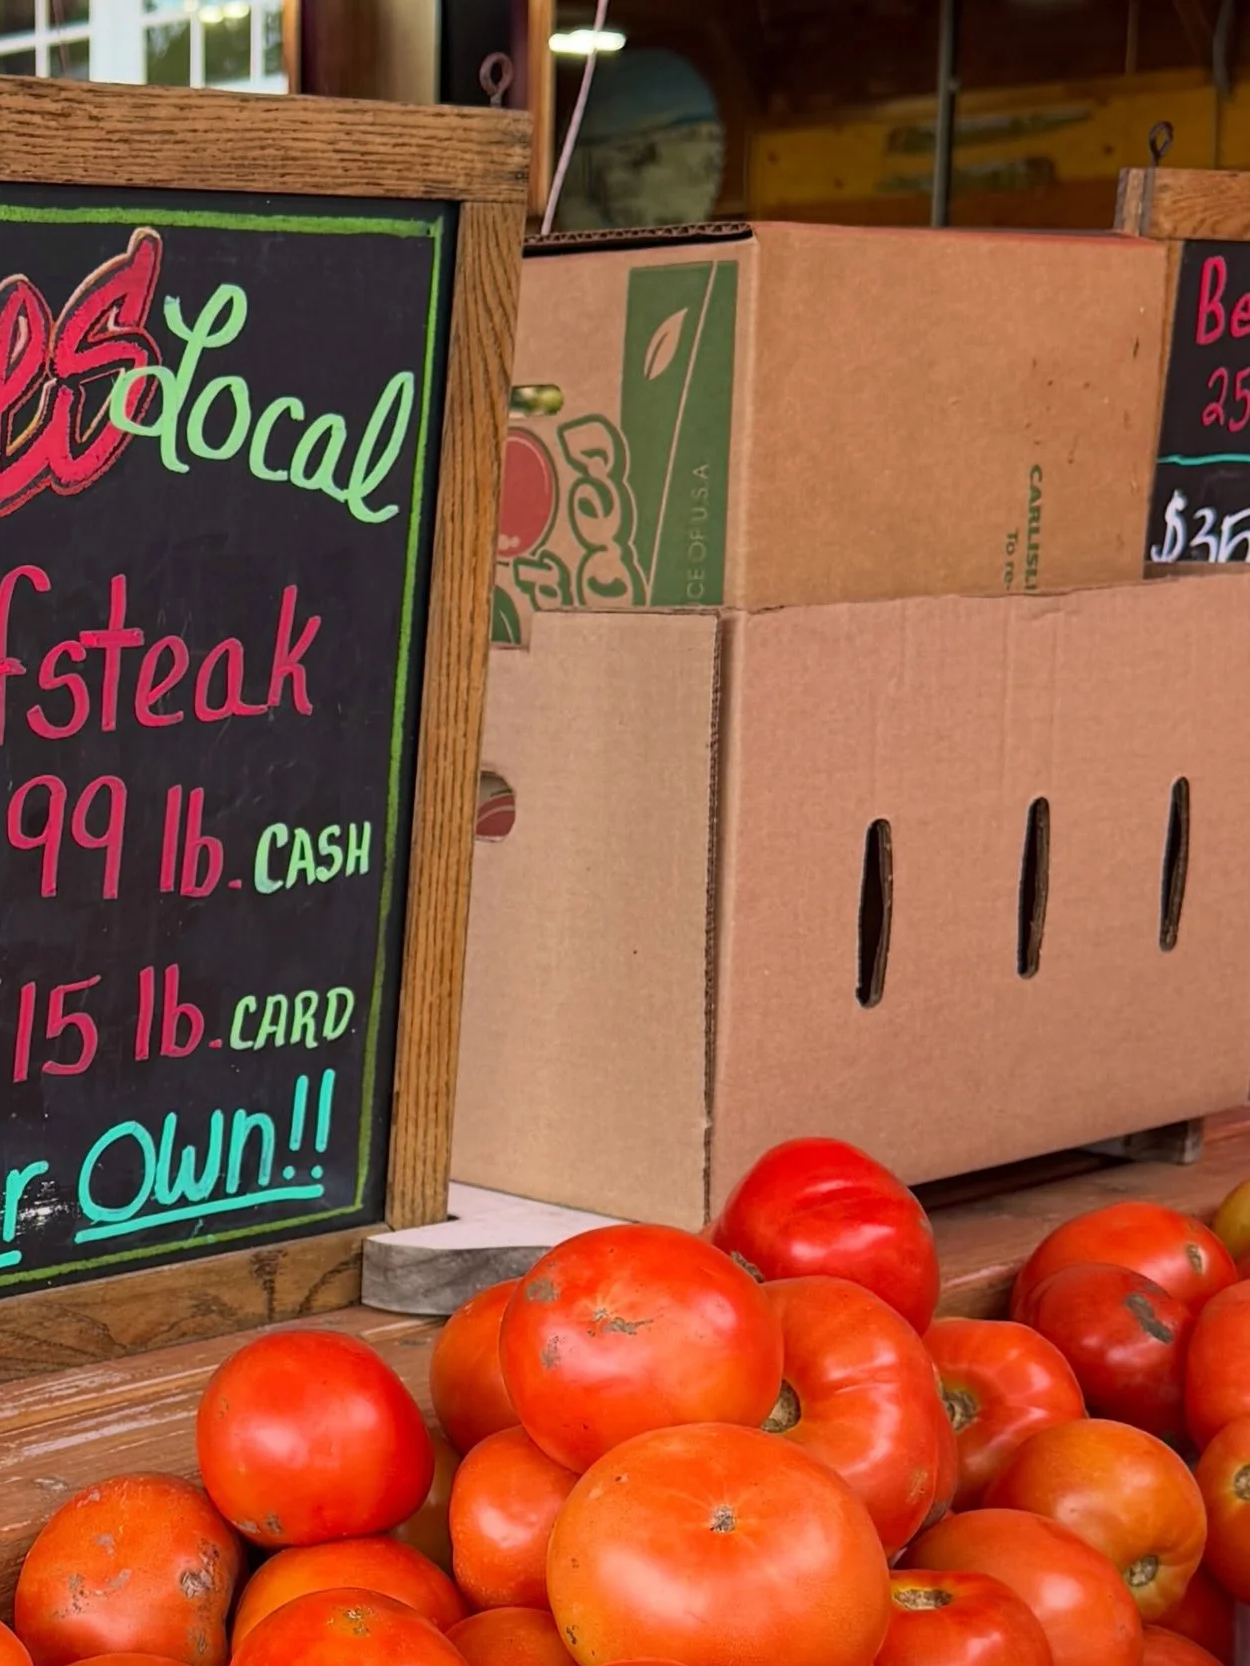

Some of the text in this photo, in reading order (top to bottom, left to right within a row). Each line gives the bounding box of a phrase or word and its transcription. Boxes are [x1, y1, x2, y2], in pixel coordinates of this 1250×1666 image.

[110, 284, 415, 523] Local
[159, 786, 242, 898] lb.
[254, 820, 372, 895] CASH
[134, 963, 222, 1062] lb.
[229, 986, 355, 1052] CARD
[76, 1068, 337, 1224] Own!!
